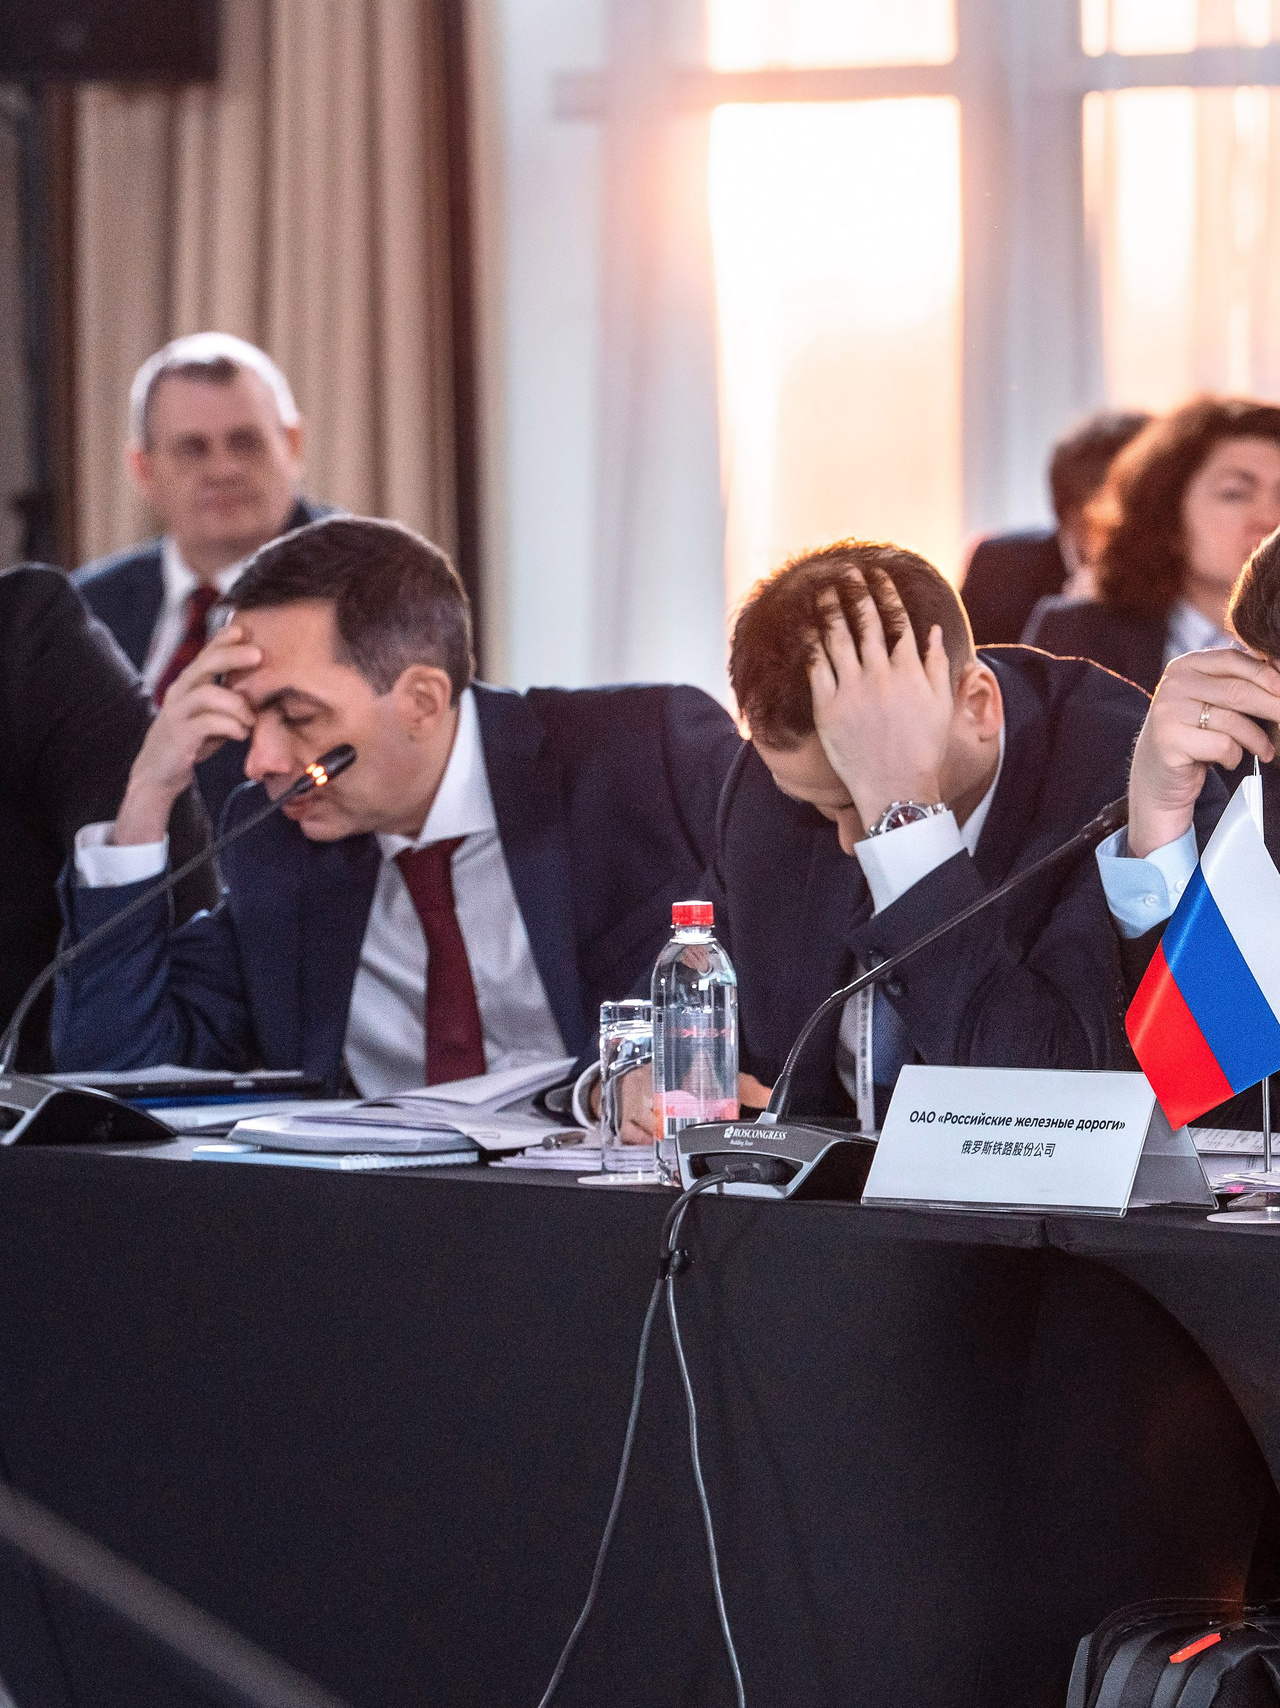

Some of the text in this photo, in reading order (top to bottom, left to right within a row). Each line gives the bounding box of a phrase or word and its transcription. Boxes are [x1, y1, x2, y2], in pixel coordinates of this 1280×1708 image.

[909, 1110, 1126, 1132] ОАО «Российские железные дороги»
[733, 1128, 788, 1141] ROSCONGRESS
[960, 1140, 1056, 1158] 俄罗斯铁路股份公司
